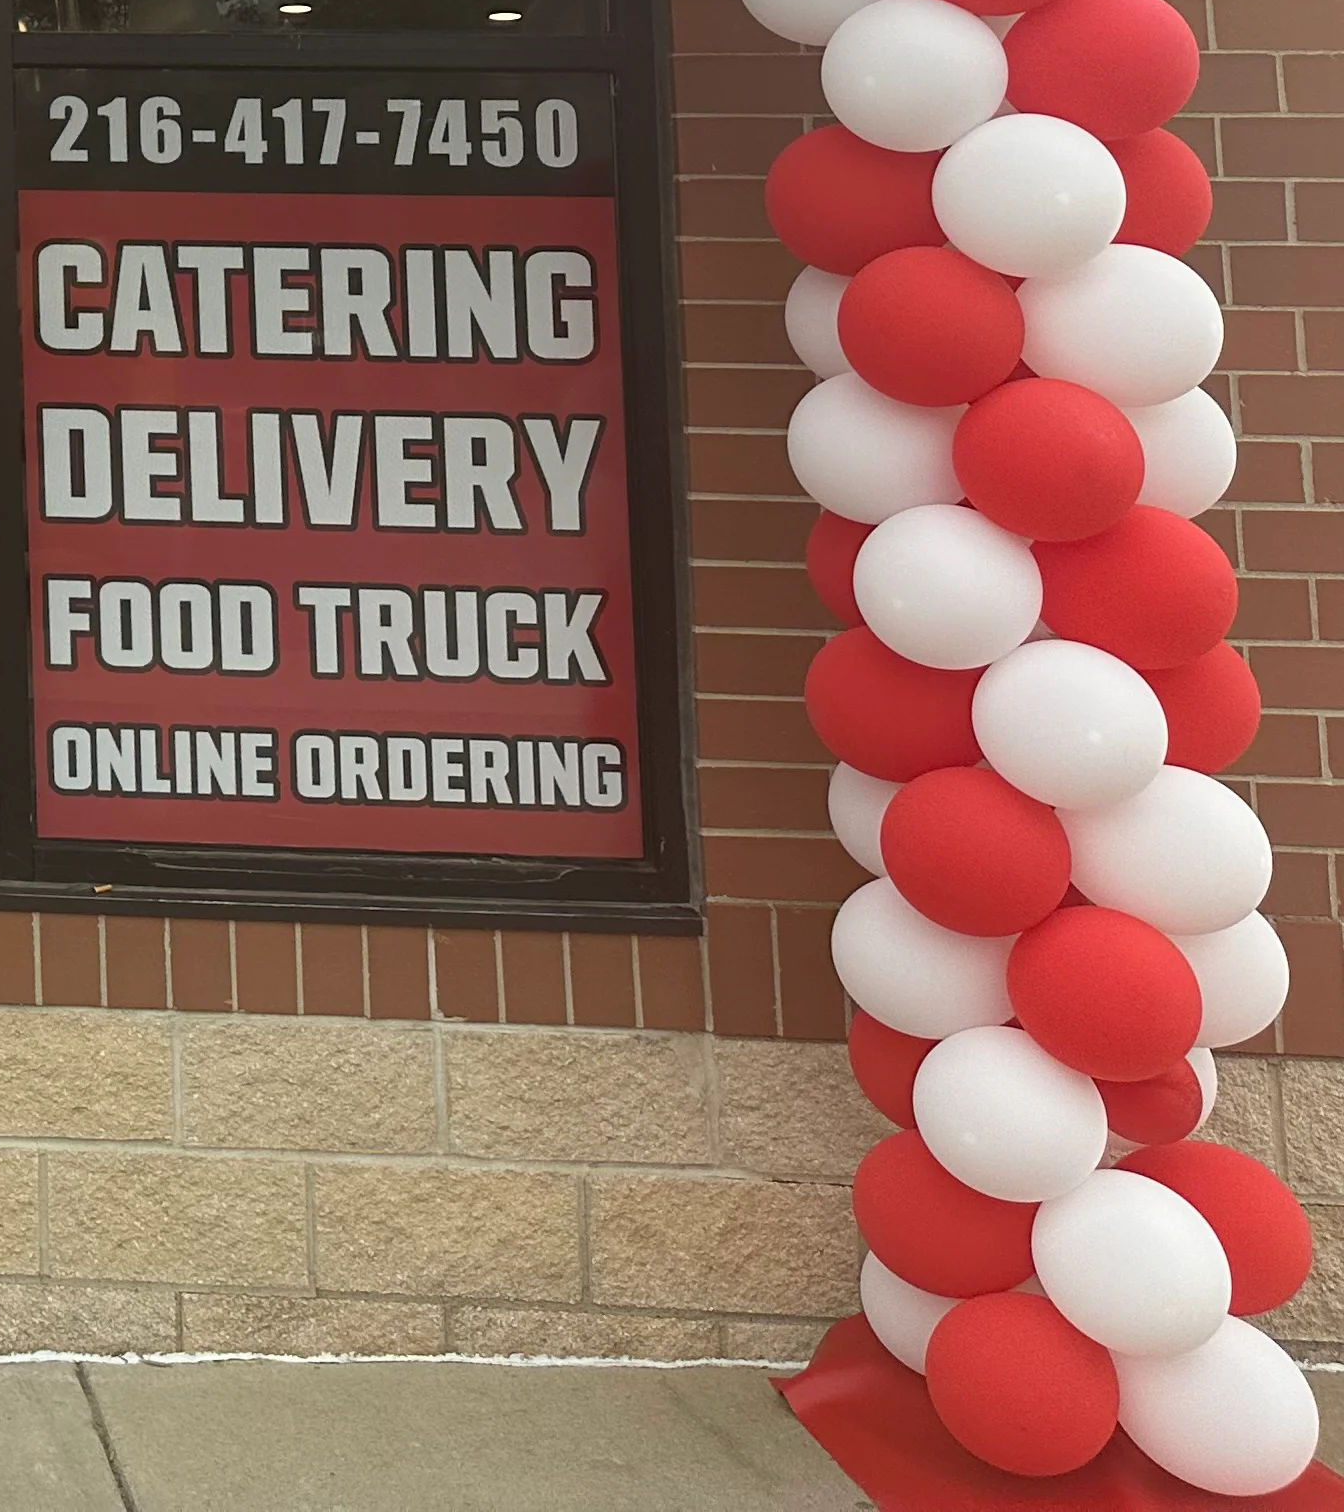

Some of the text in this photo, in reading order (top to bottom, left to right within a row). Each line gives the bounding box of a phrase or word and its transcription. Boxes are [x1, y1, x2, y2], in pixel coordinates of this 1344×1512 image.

[48, 95, 579, 168] 216-417-7450
[35, 241, 597, 361] CATERING
[39, 405, 606, 533] DELIVERY
[44, 577, 608, 683] FOOD TRUCK
[50, 724, 625, 808] ONLINE ORDERING
